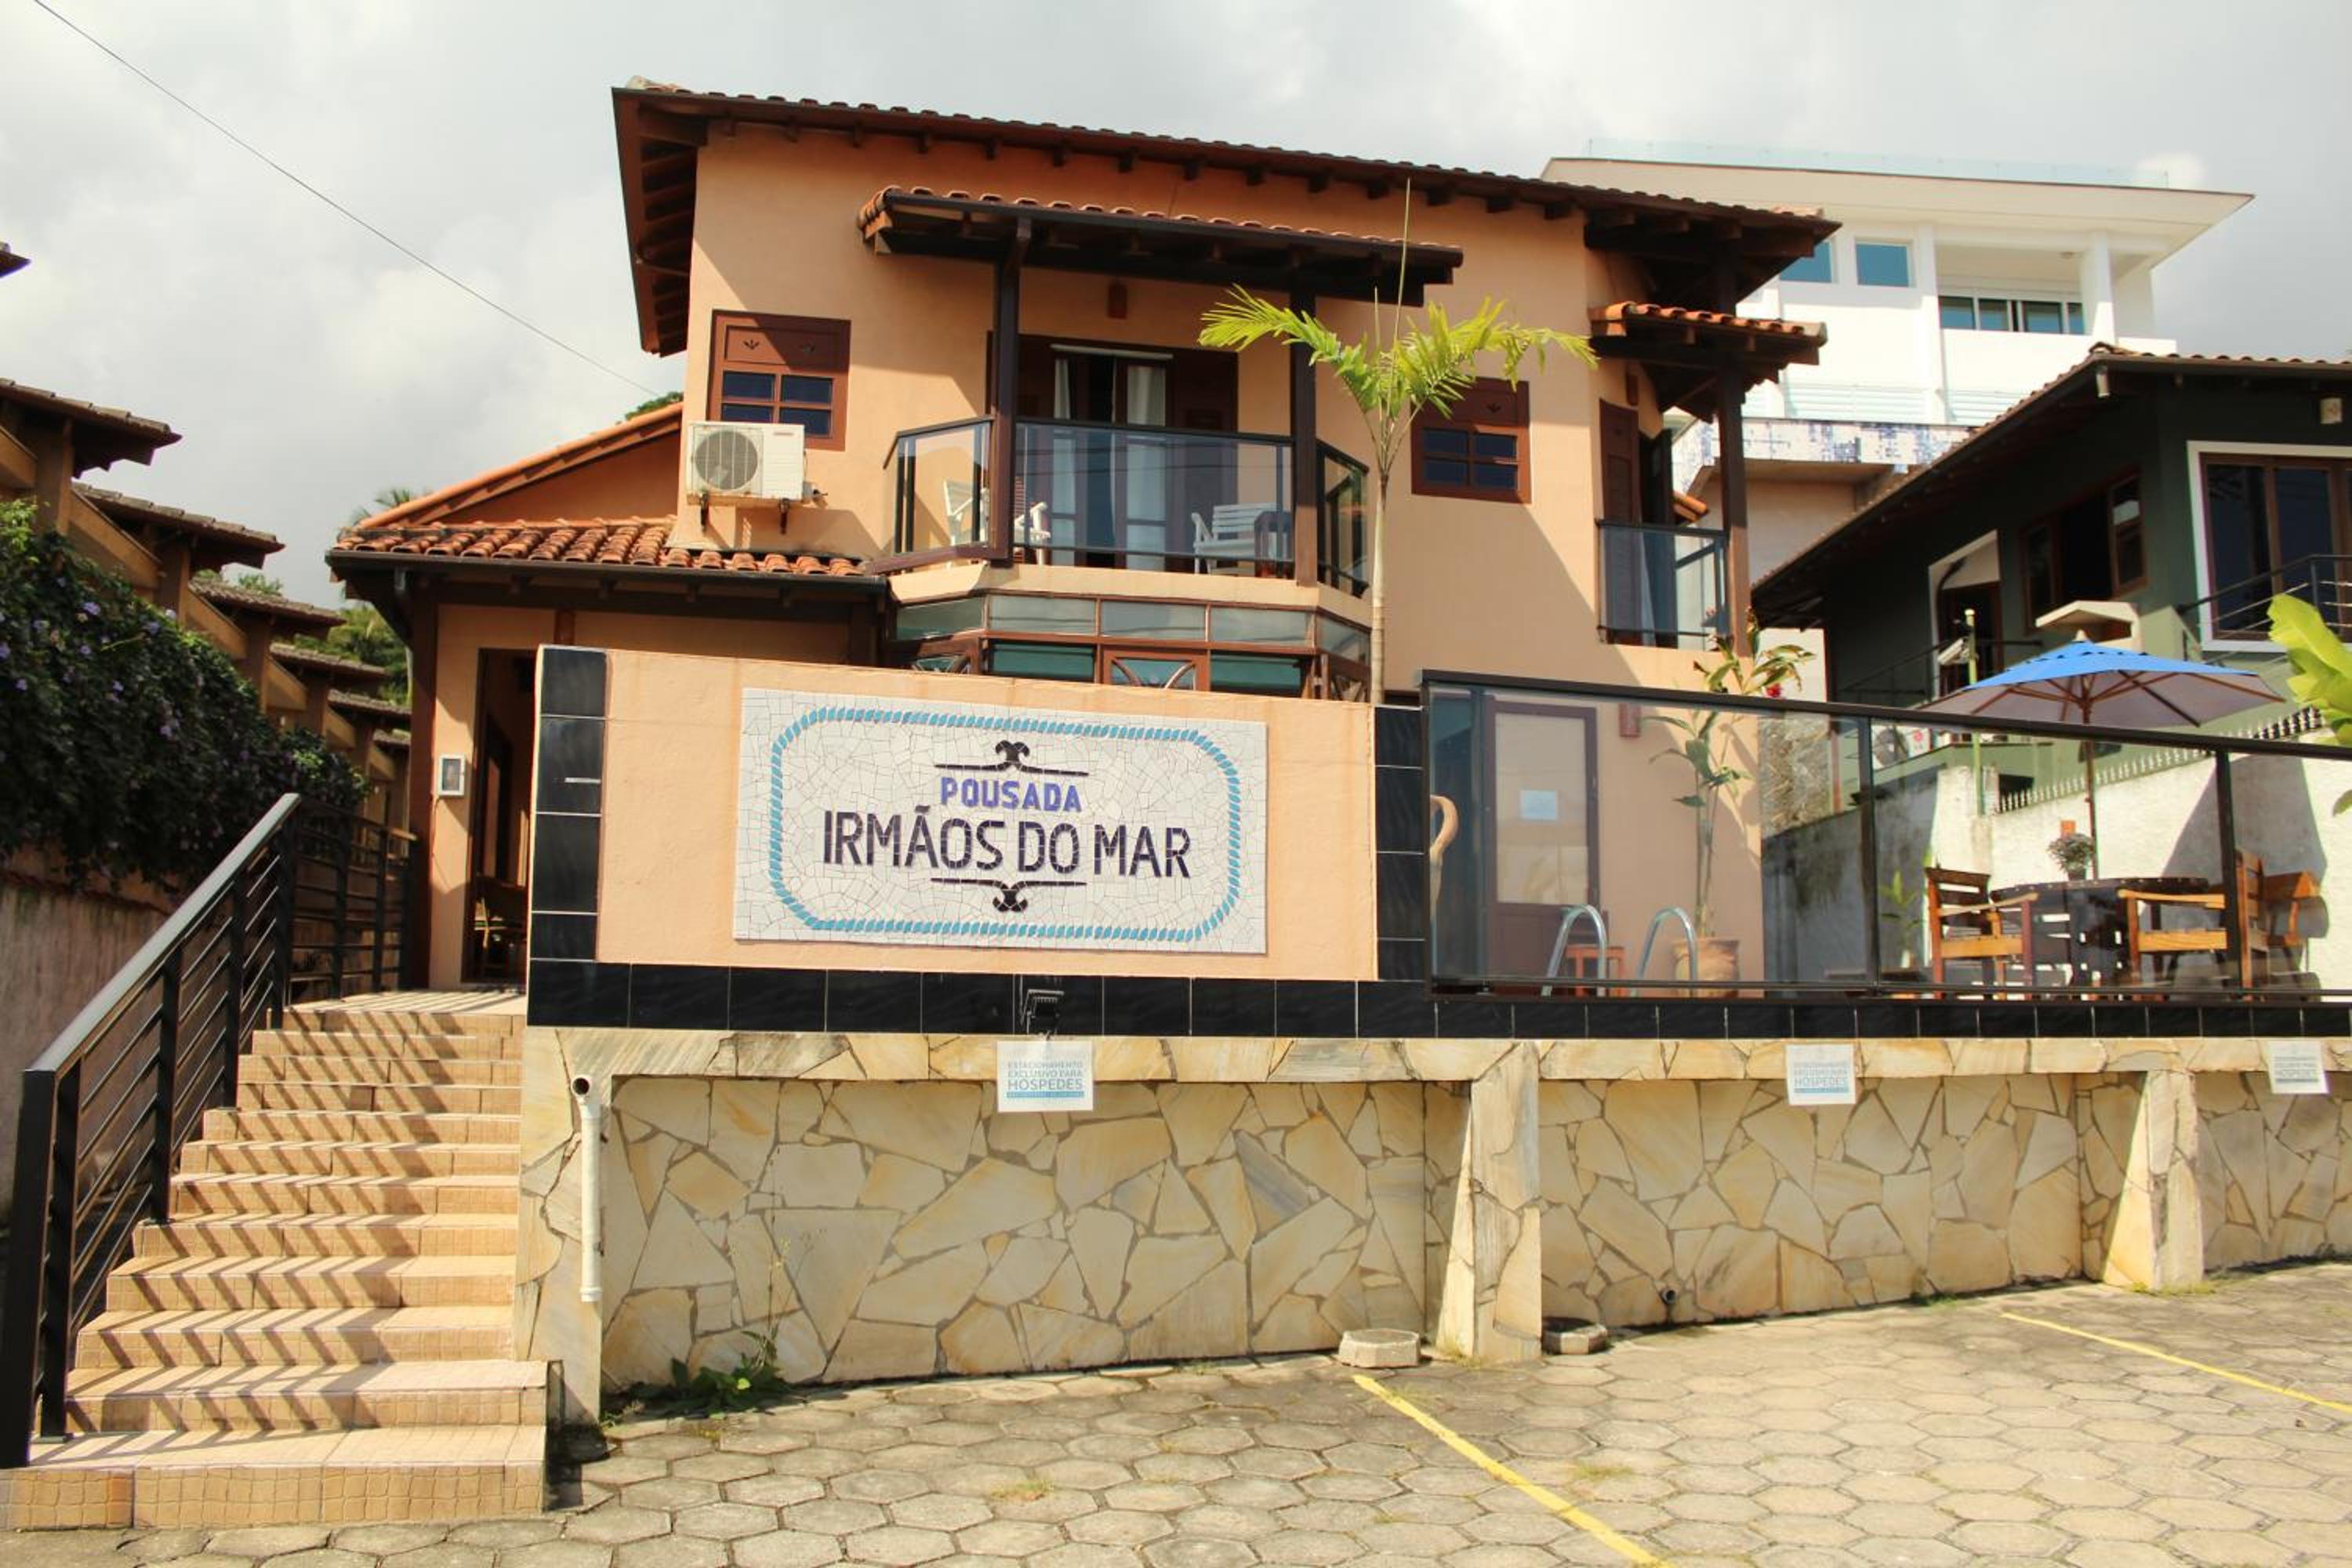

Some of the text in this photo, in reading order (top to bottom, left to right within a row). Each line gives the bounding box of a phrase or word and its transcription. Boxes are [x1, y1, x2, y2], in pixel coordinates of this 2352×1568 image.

[941, 776, 1082, 812] POUSADA
[824, 805, 1191, 878] IRMÃOS DO MAR
[1007, 1069, 1058, 1078] EXCLUSIVO
